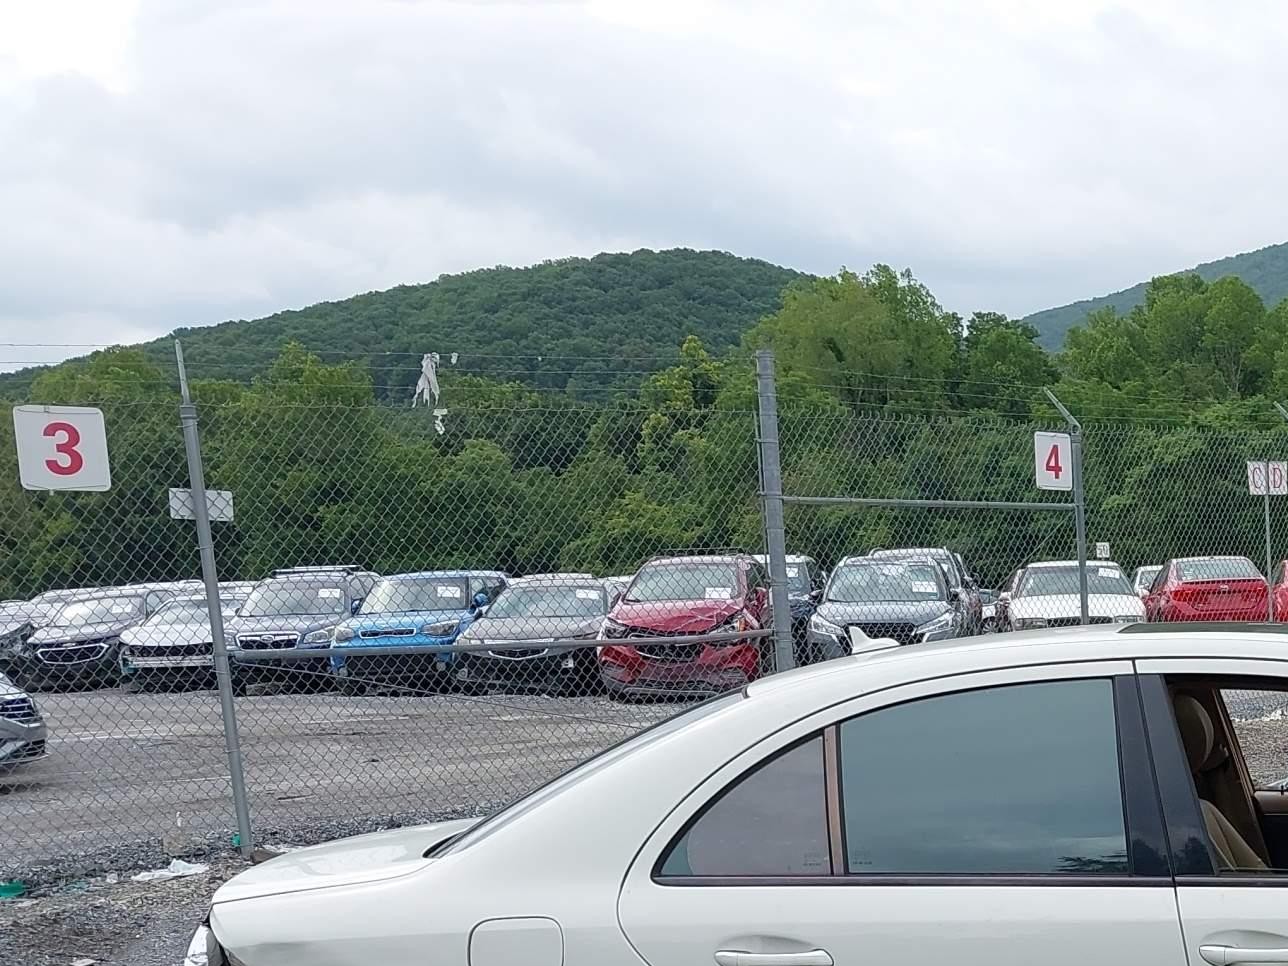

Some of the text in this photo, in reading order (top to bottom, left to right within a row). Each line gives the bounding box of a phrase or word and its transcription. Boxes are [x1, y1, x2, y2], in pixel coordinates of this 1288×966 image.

[43, 422, 83, 475] 3
[1045, 444, 1063, 479] 4
[1252, 466, 1264, 489] C
[1272, 466, 1283, 489] D
